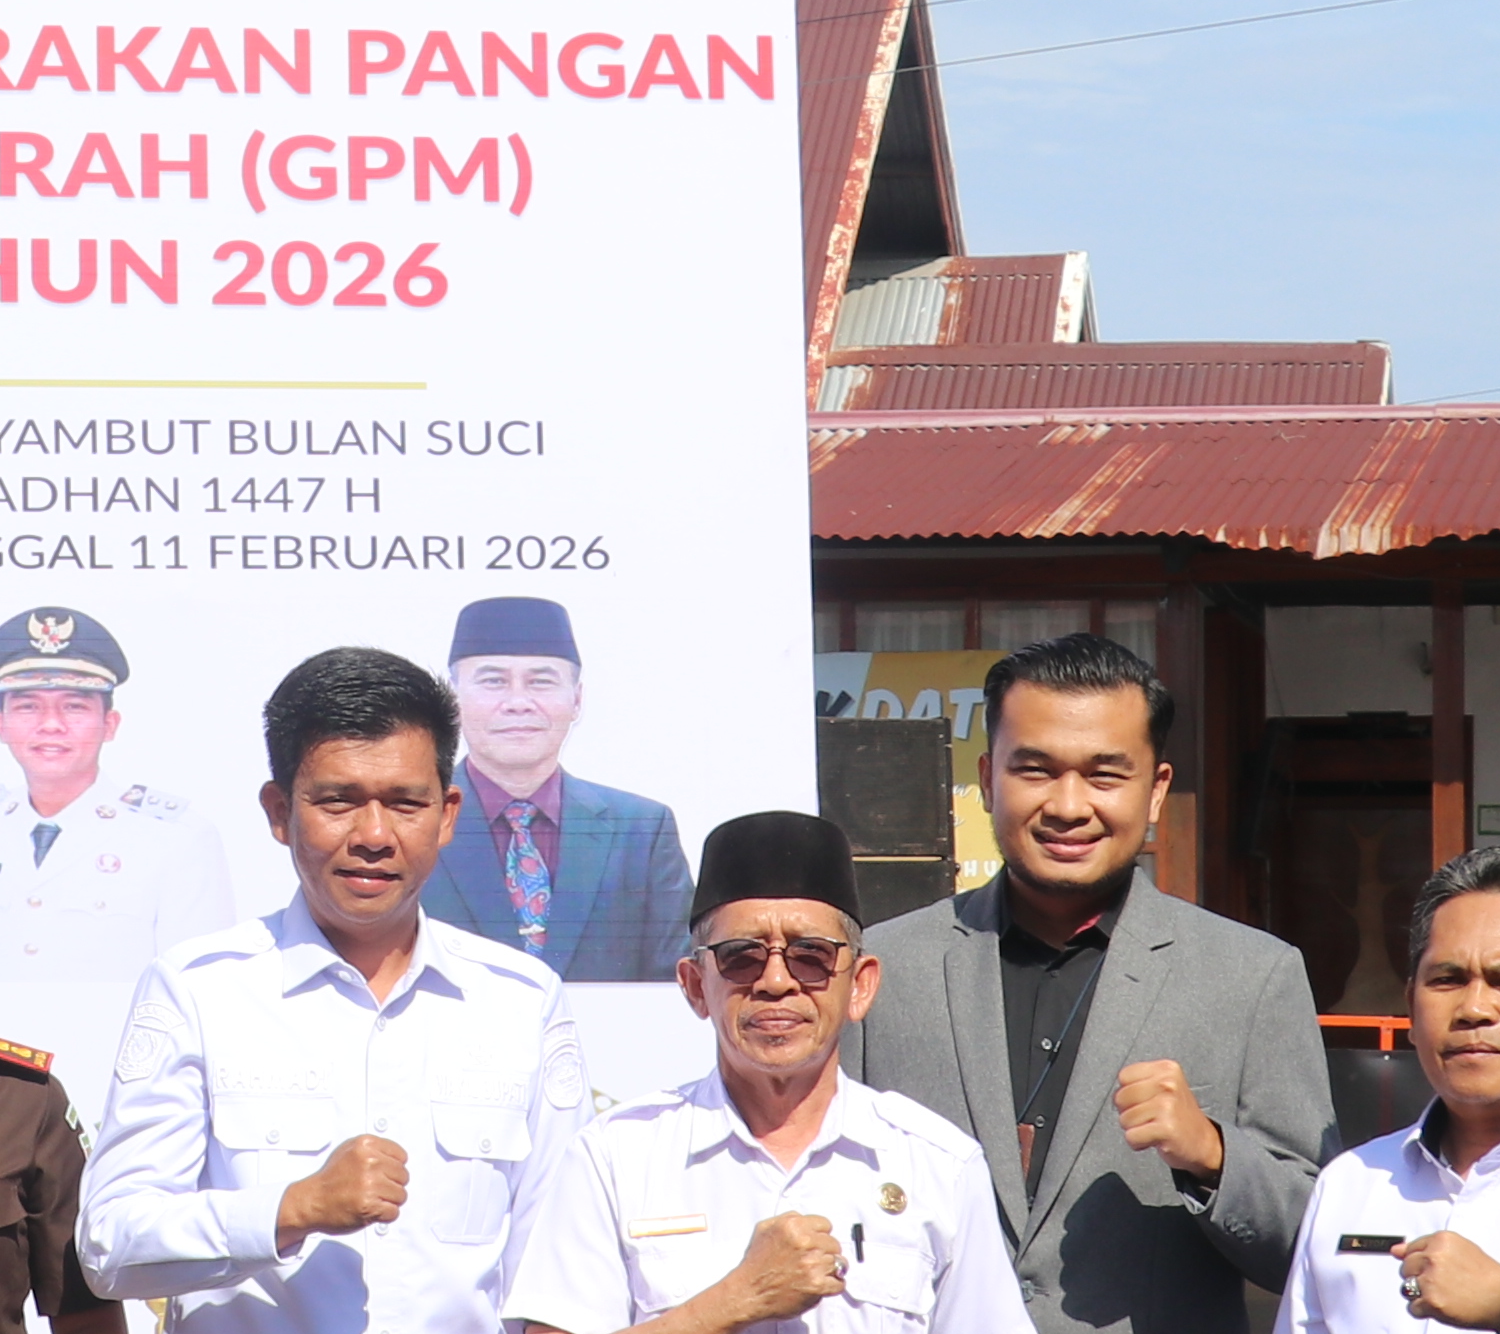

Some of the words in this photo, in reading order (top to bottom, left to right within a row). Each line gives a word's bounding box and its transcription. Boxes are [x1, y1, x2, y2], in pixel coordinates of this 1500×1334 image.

[347, 29, 775, 101] PANGAN
[241, 129, 533, 217] (GPM)
[211, 239, 449, 308] 2026
[228, 419, 407, 456] BULAN
[427, 420, 544, 457] SUCI
[202, 476, 326, 513] 1447
[345, 477, 381, 513] H
[130, 534, 188, 570] 11
[209, 535, 465, 571] FEBRUARI
[485, 535, 610, 571] 2026
